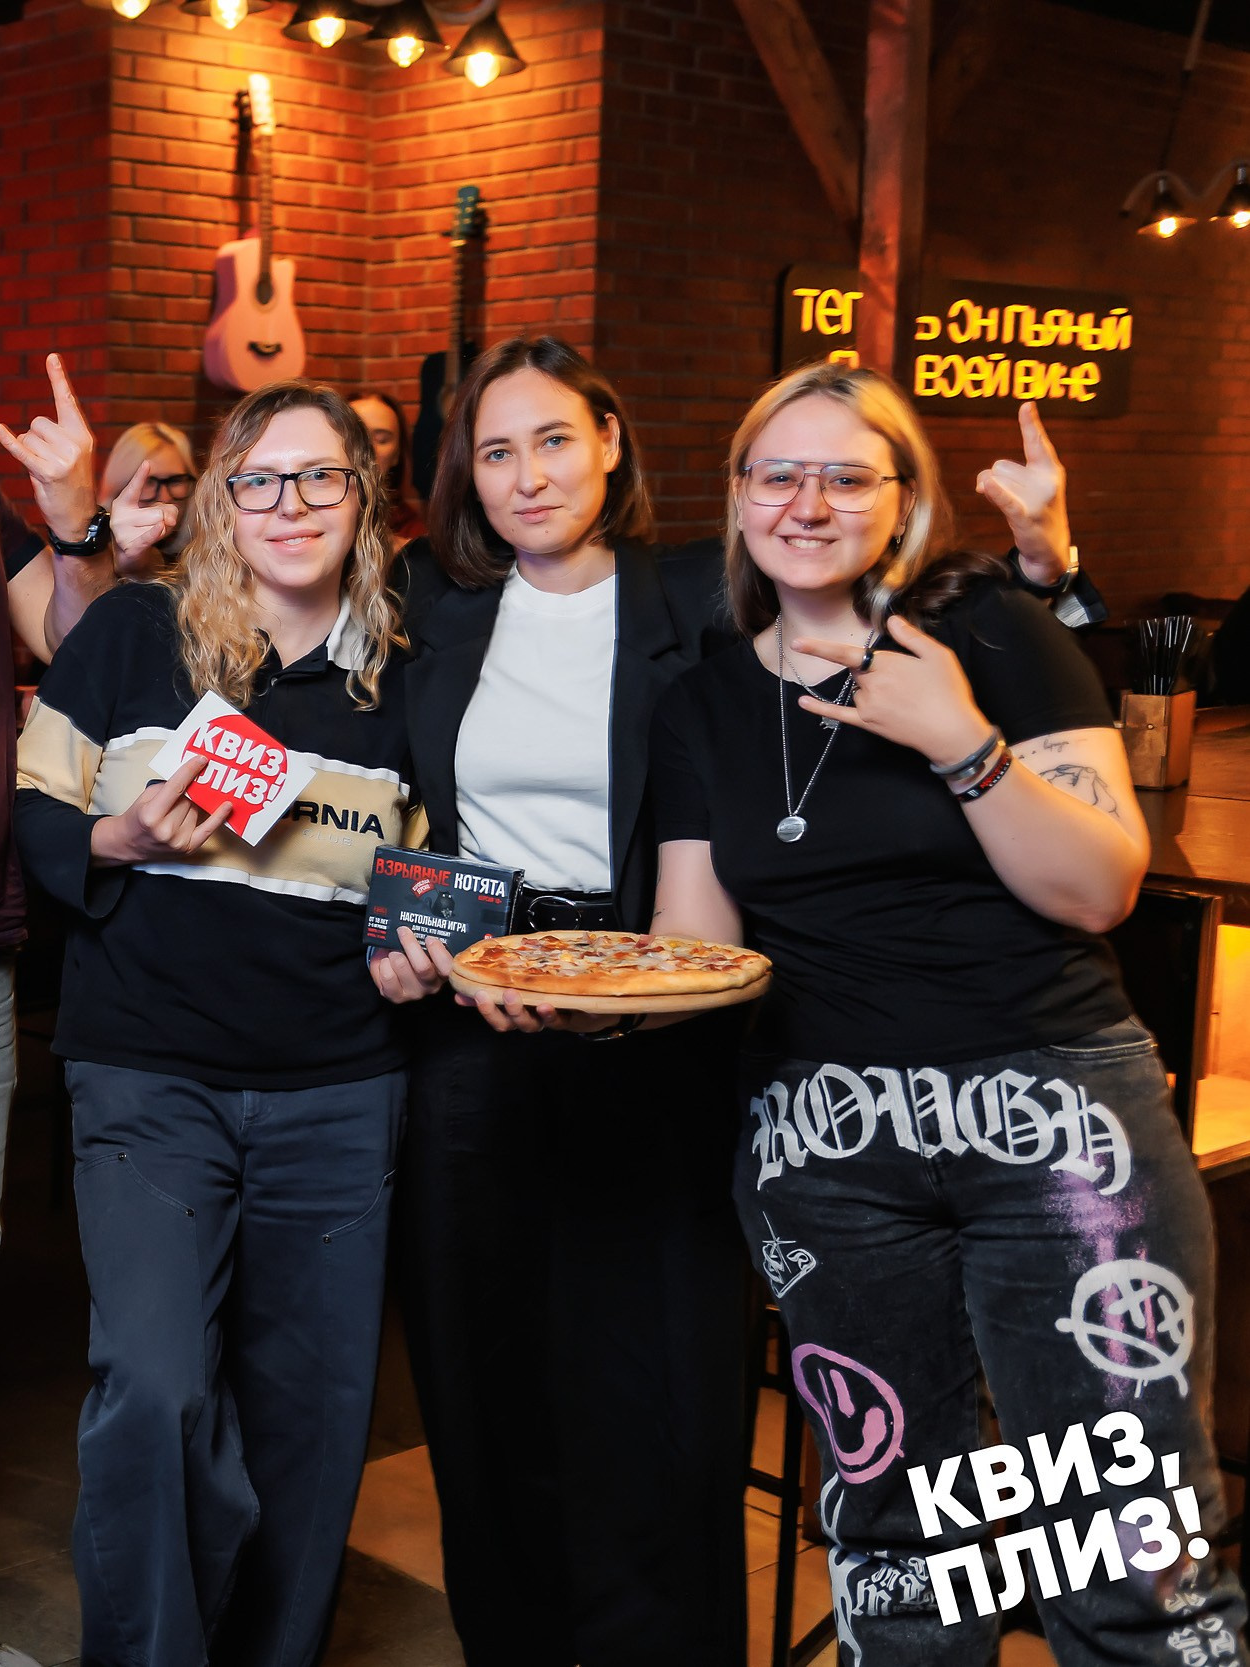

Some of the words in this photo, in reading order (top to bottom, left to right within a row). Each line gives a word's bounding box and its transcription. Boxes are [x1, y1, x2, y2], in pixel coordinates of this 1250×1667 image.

[192, 723, 287, 786] КВИЗ,
[282, 800, 385, 840] RNIA
[375, 857, 452, 887] ВЗРЫВНЫЕ
[454, 872, 506, 898] КОТЯТА
[399, 911, 447, 930] НАСТОЛЬНАЯ
[447, 920, 467, 934] ИГРА
